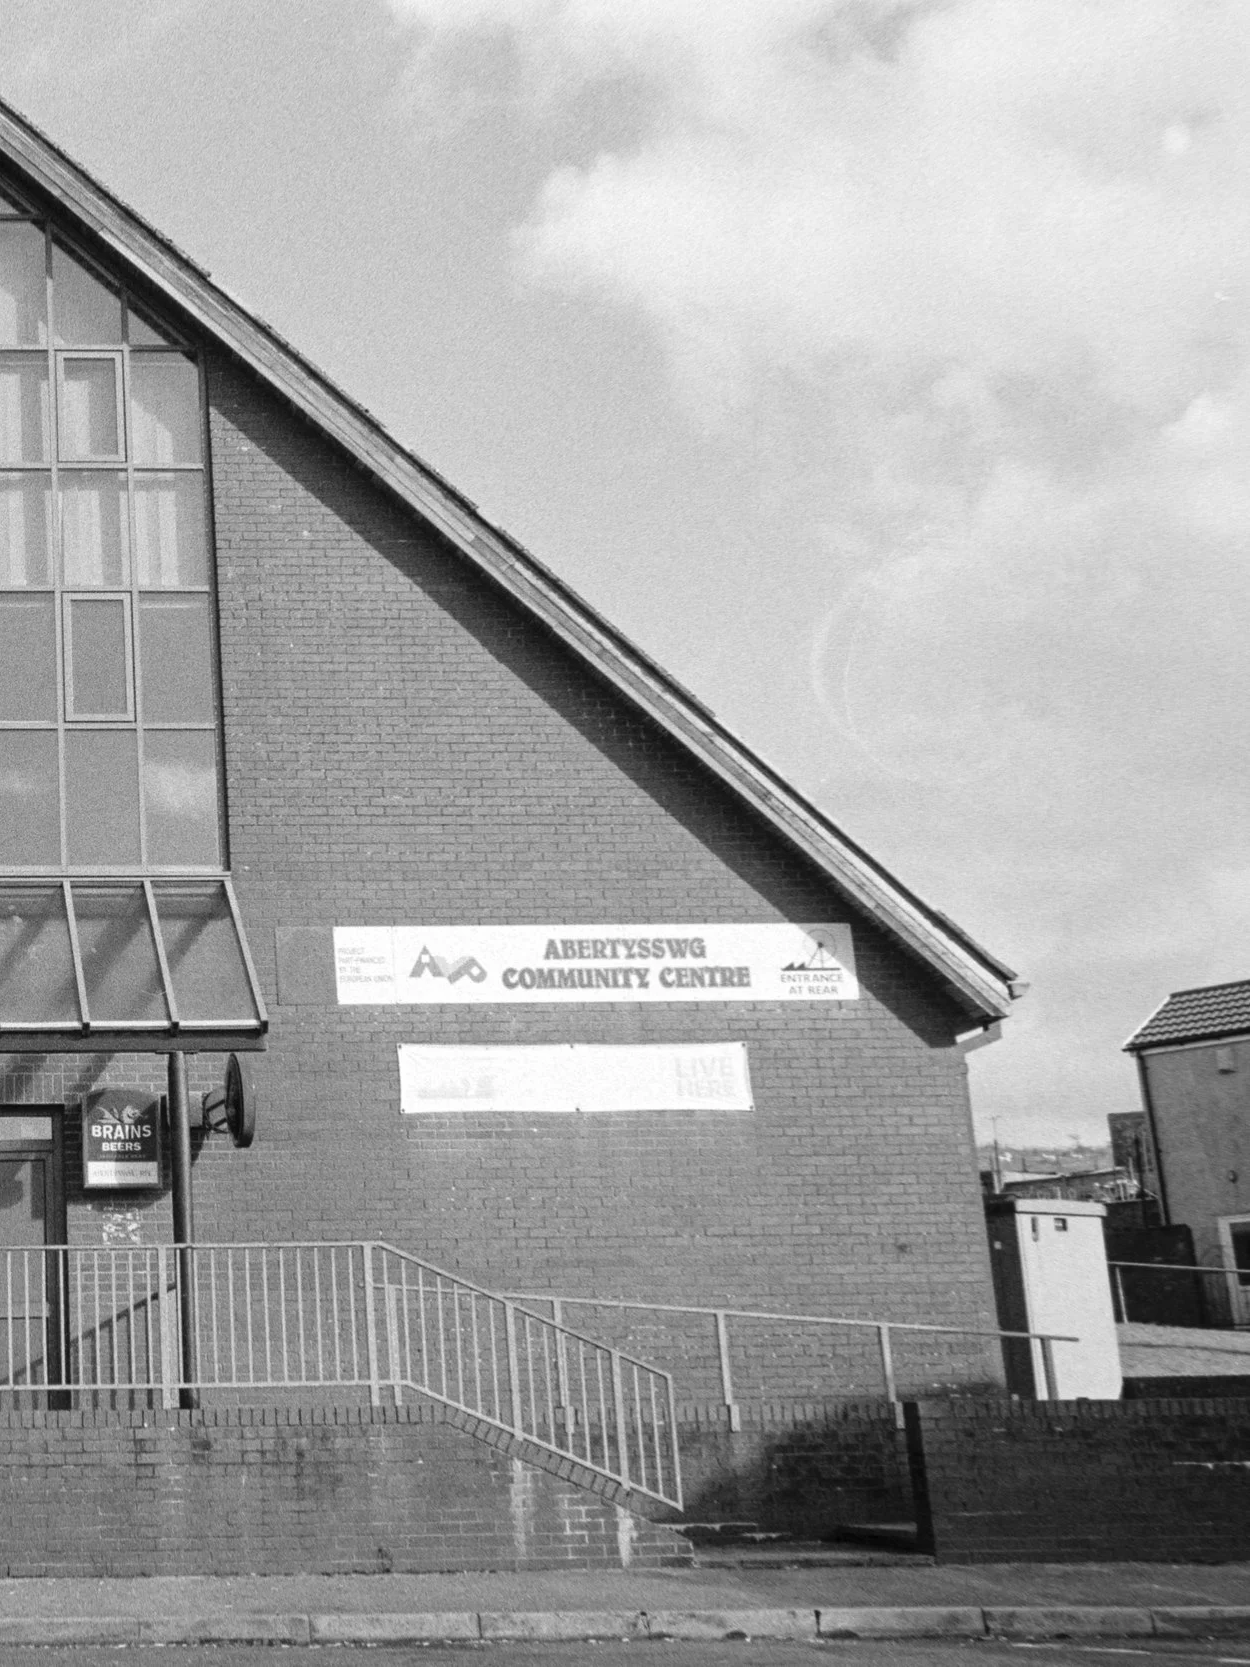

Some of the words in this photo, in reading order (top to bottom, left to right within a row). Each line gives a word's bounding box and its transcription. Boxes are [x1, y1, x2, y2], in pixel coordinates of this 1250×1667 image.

[543, 938, 707, 960] ABERTYSSWG
[502, 967, 650, 989] COMMUNITY
[658, 966, 751, 988] CENTRE
[780, 973, 843, 983] ENTRANCE
[788, 986, 803, 995] AT
[807, 986, 839, 995] REAR
[91, 1124, 152, 1140] BRAINS
[102, 1142, 142, 1152] BEERS
